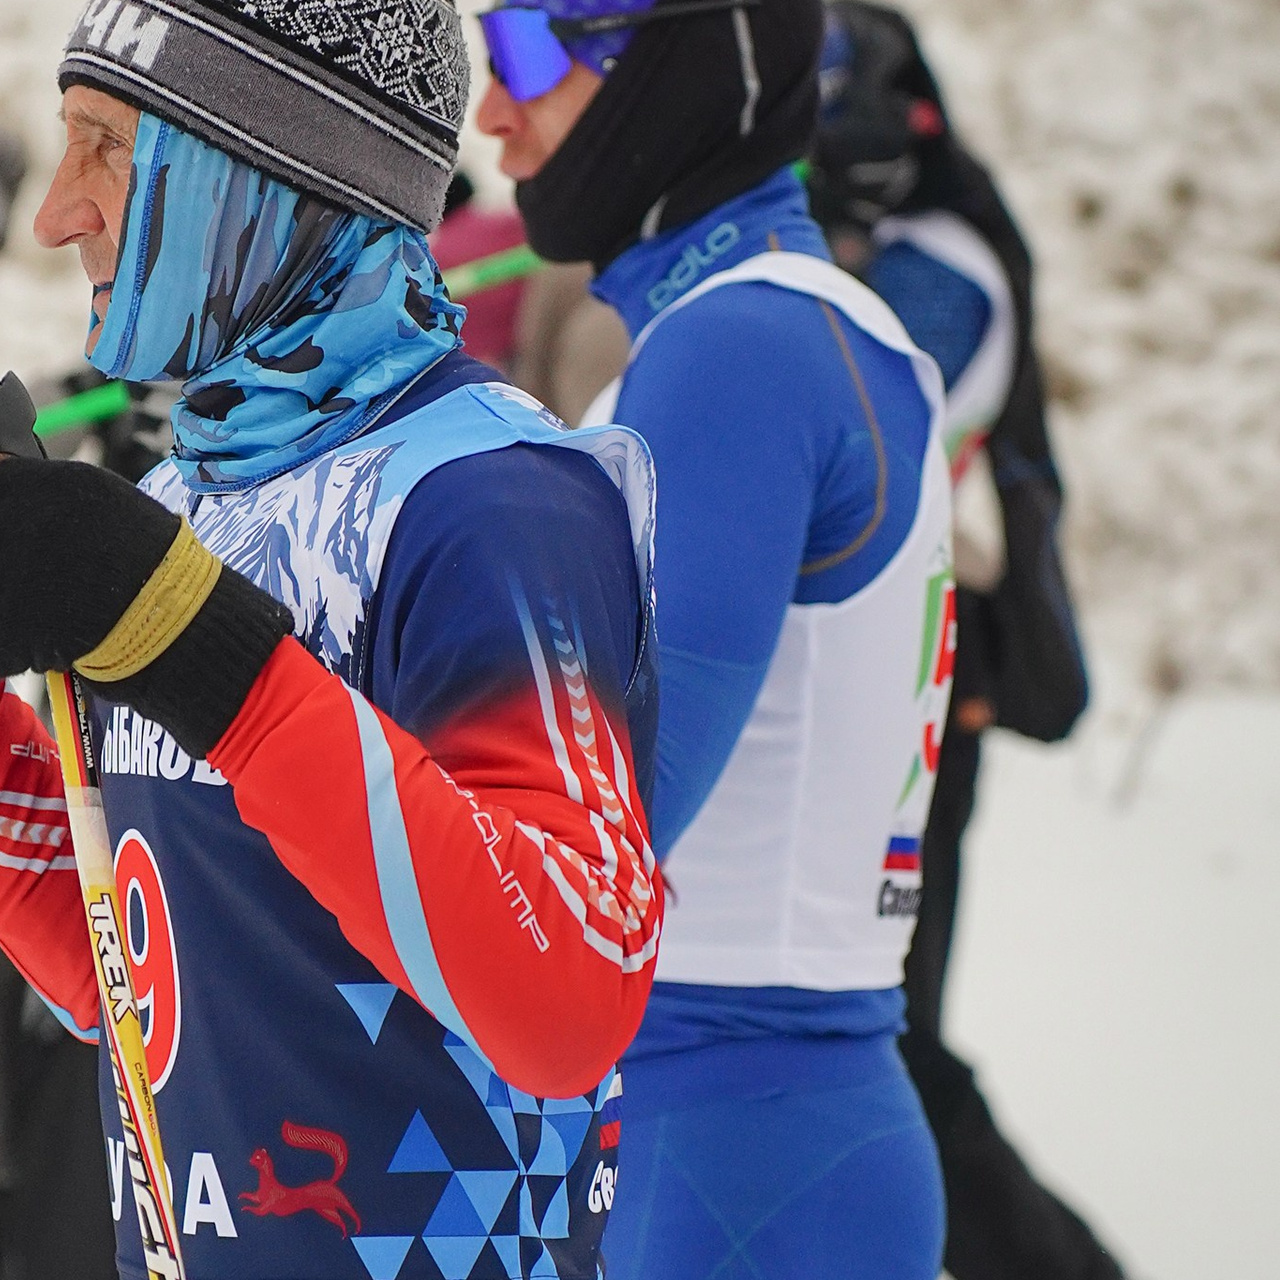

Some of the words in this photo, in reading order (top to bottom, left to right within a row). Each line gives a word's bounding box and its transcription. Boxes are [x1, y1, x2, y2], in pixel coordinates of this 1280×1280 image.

[88, 891, 140, 1026] TREK
[113, 827, 182, 1097] 9
[134, 1062, 152, 1113] CARBON
[108, 1137, 238, 1238] УА
